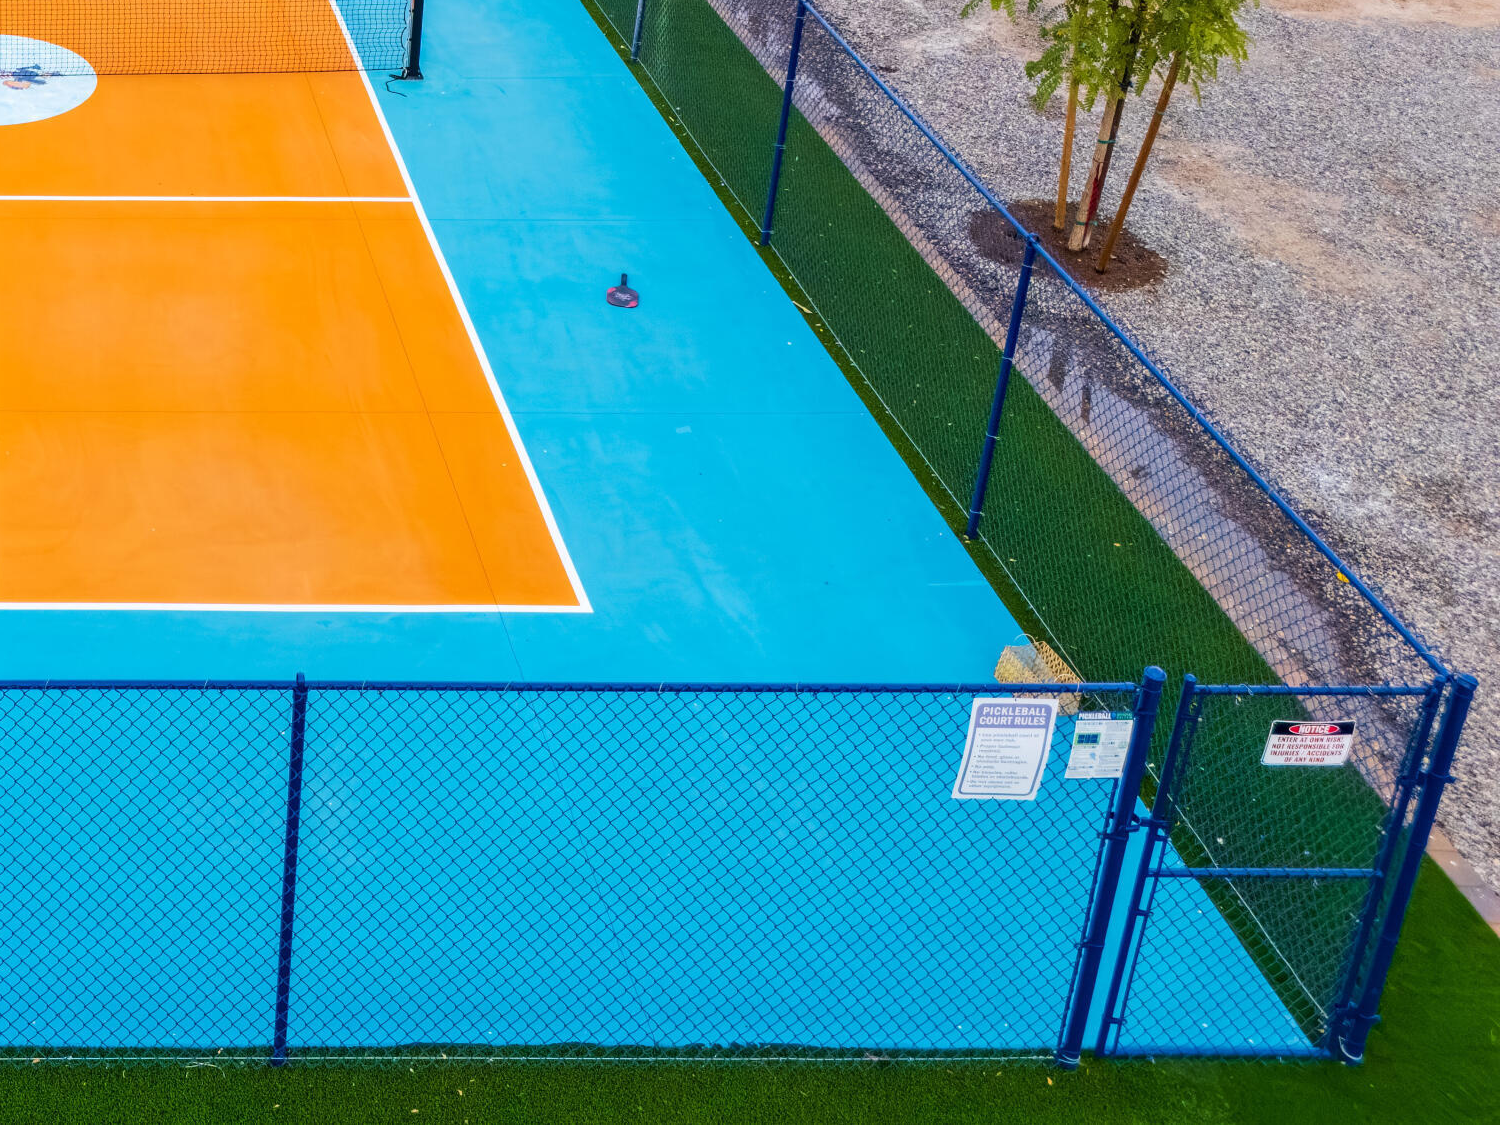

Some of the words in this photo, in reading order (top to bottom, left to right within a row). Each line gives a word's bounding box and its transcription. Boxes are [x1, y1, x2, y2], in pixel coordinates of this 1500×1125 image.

[983, 706, 1047, 716] PICKLEBALL
[979, 716, 1013, 725] COURT
[1014, 717, 1046, 726] RULES
[1298, 725, 1331, 734] NOTICE
